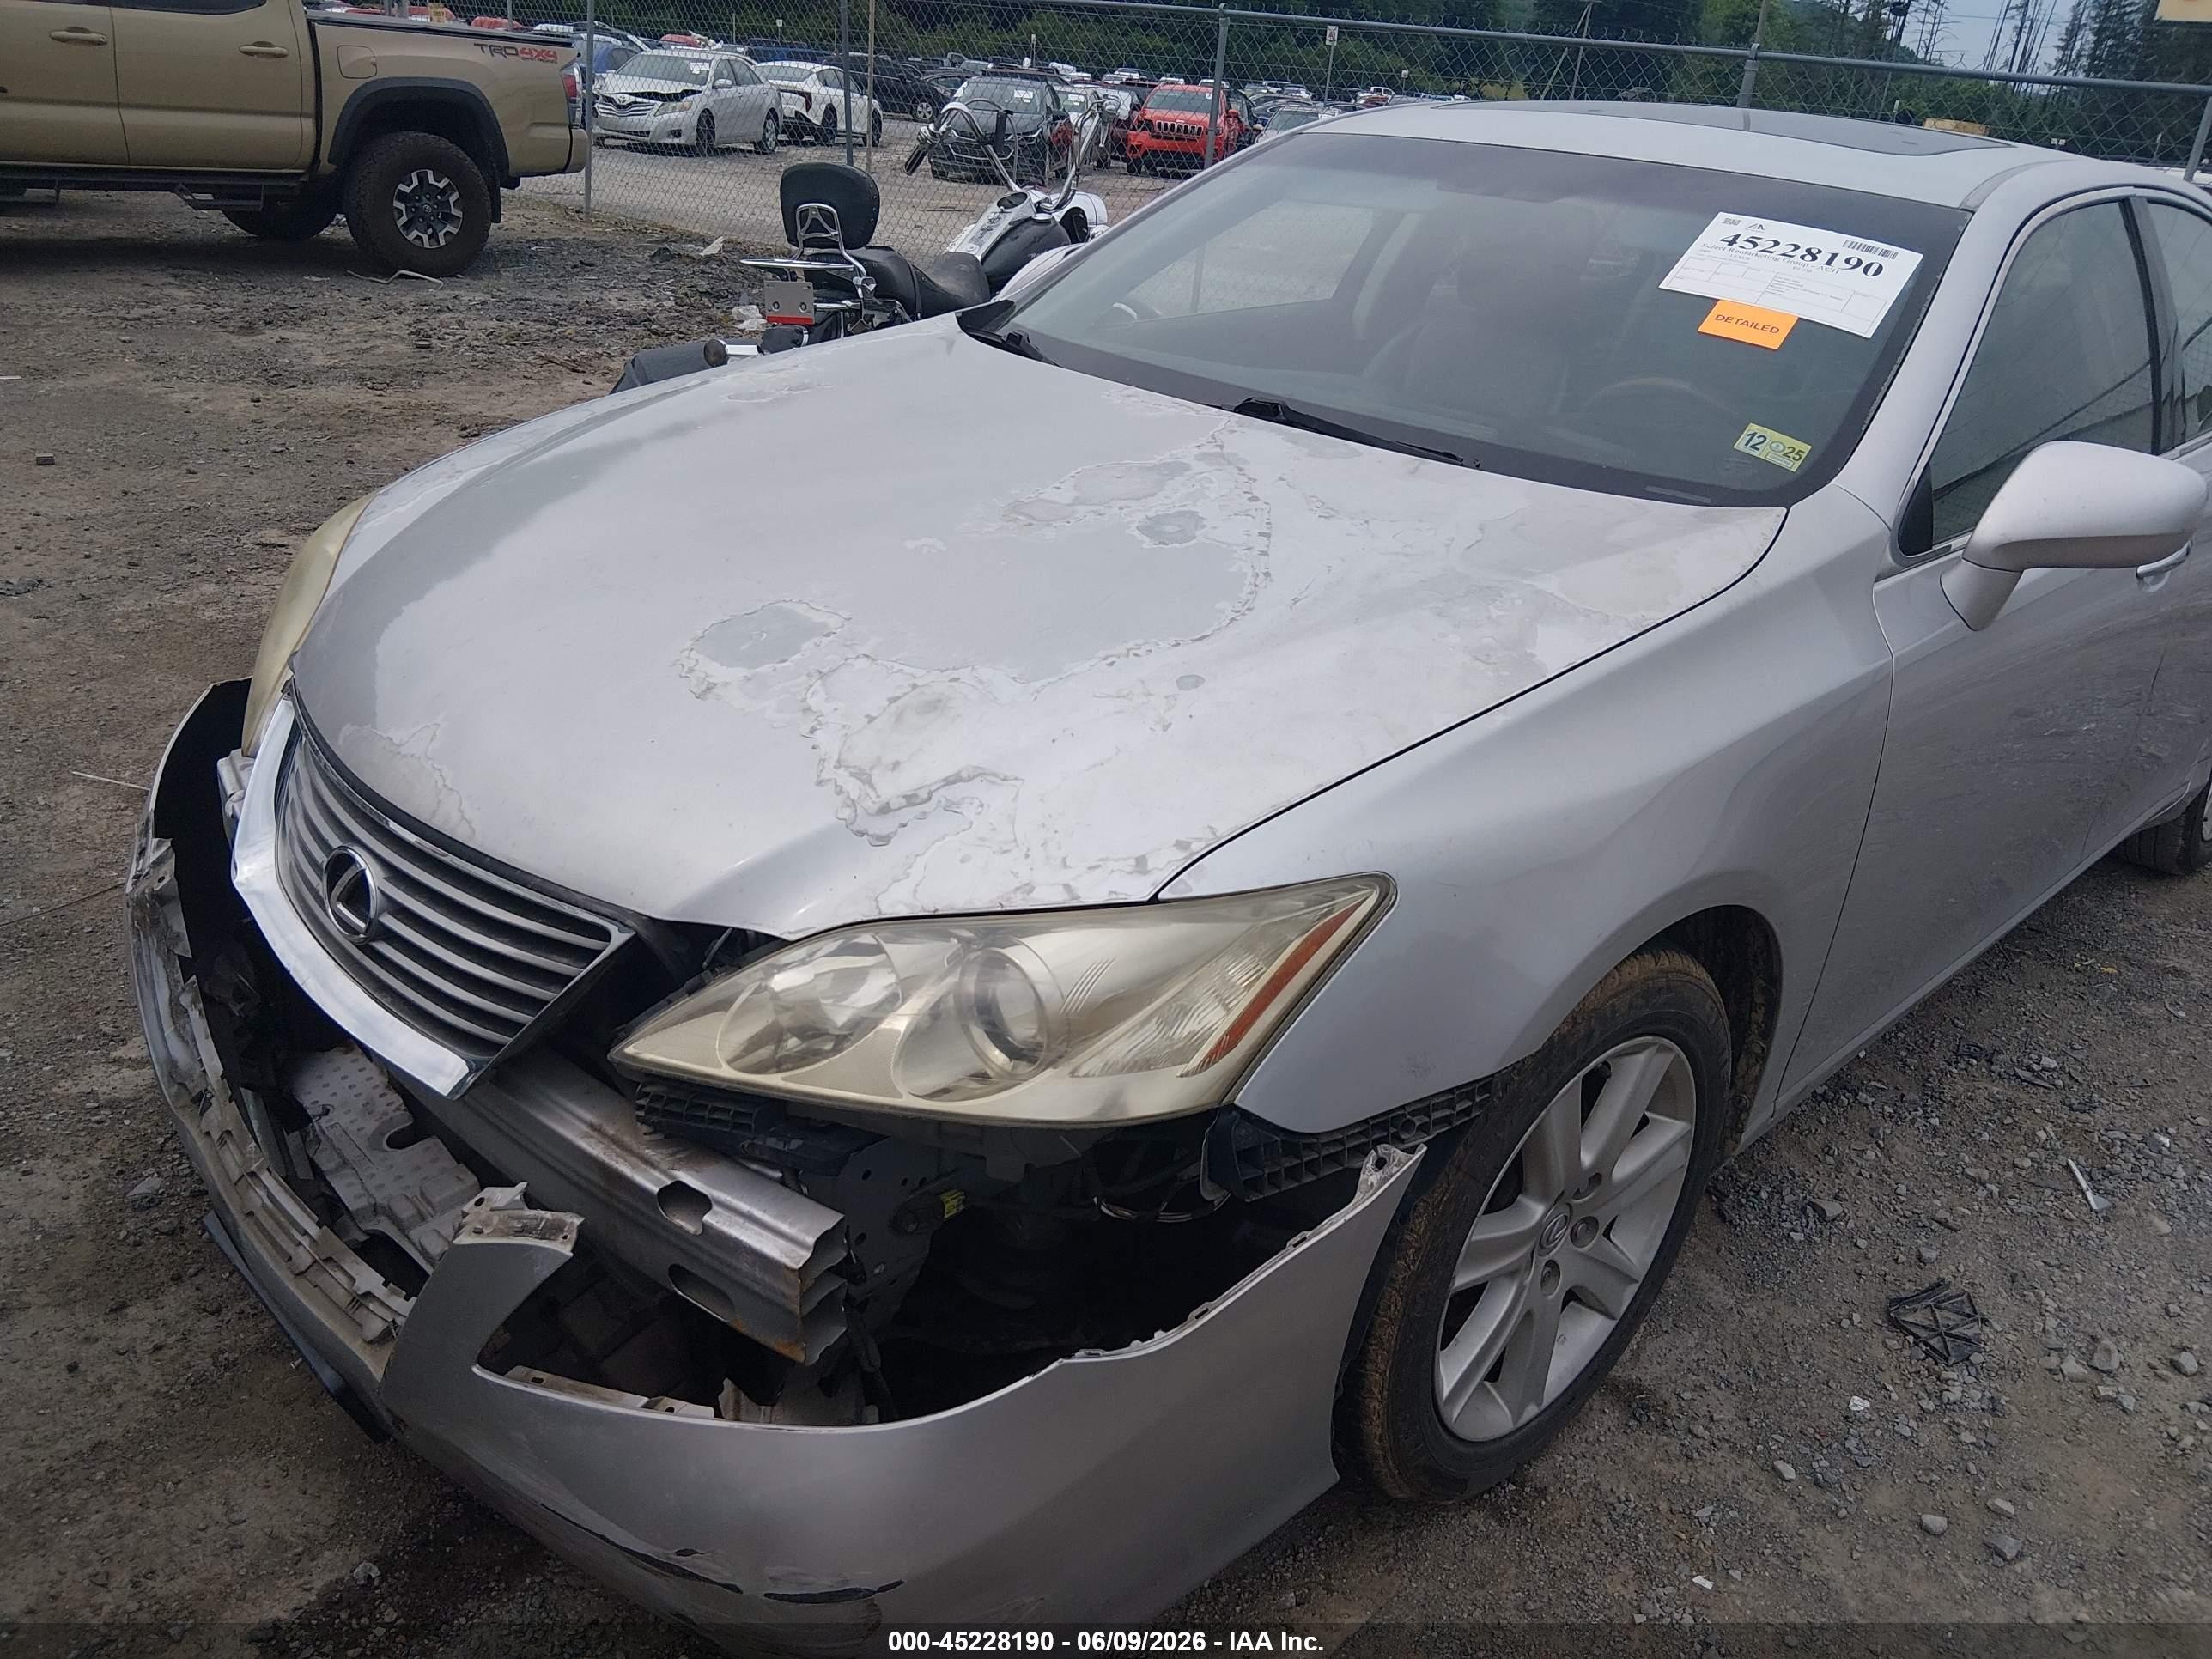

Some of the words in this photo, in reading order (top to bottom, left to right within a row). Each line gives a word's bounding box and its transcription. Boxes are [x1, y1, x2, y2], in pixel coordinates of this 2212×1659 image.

[1701, 242, 1727, 252] Select
[1728, 246, 1781, 263] Remarketing
[1782, 257, 1810, 269] Group
[1719, 232, 1884, 278] 45228190
[1714, 313, 1781, 336] DETAILED
[1744, 431, 1767, 452] 12
[1783, 446, 1805, 461] 25
